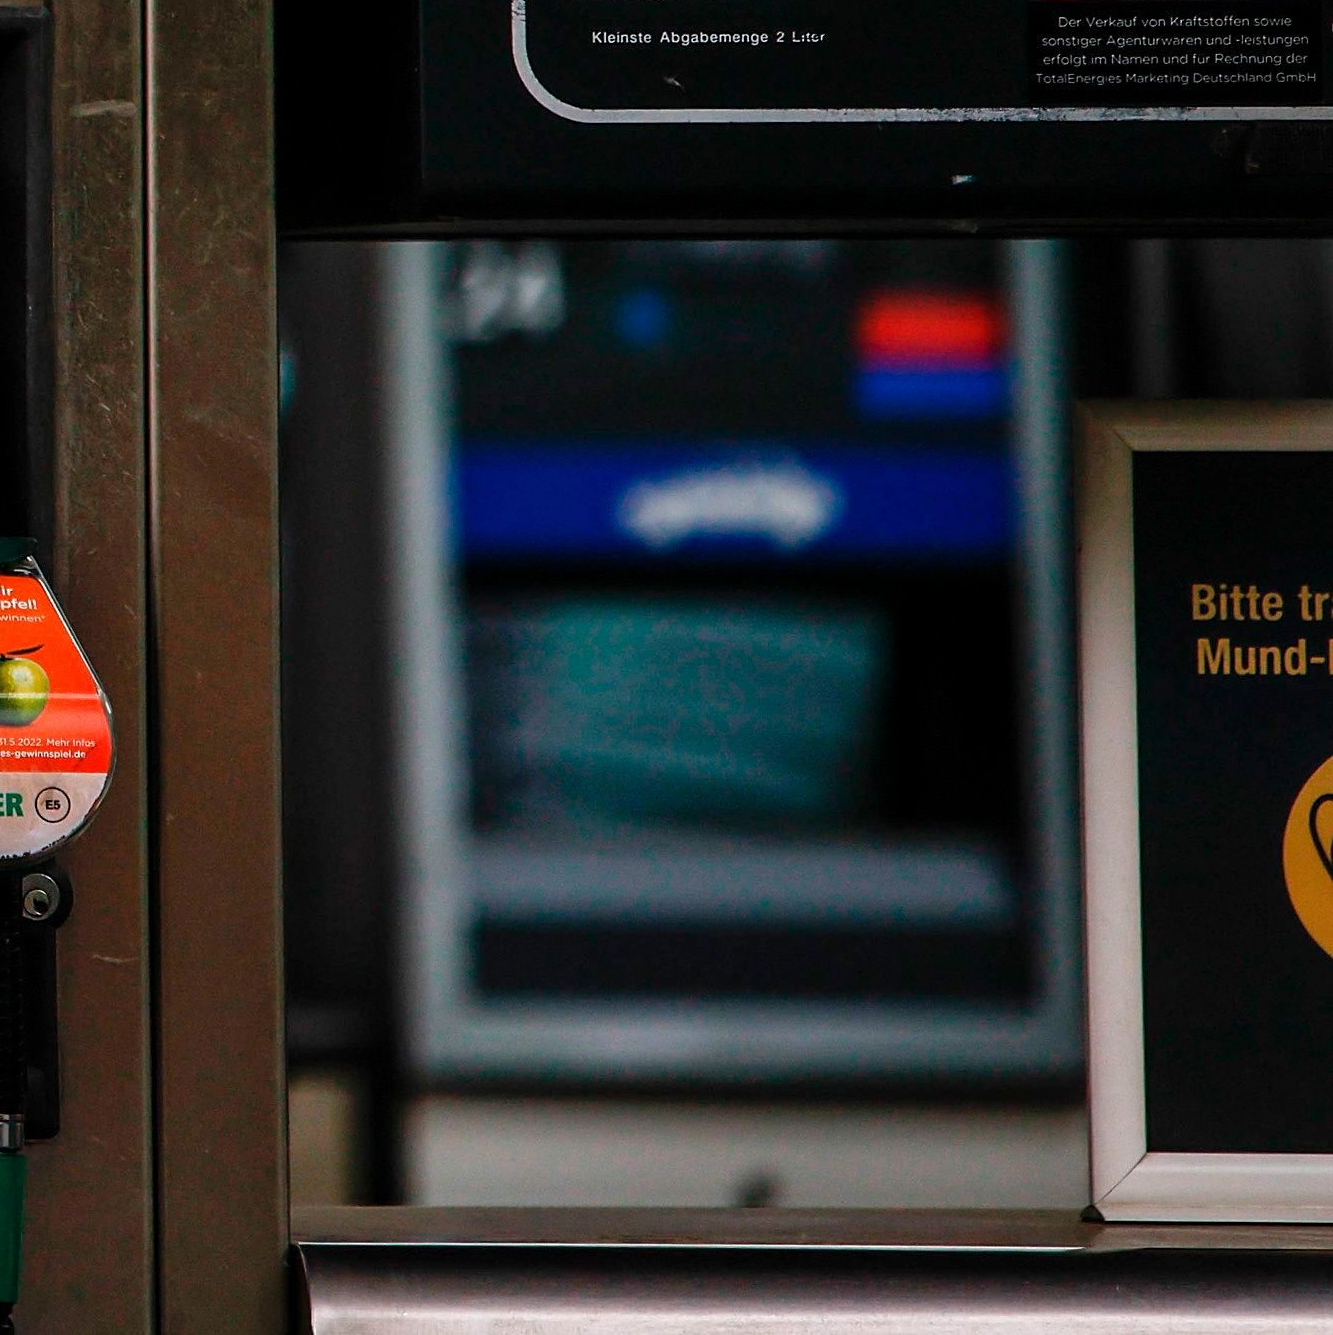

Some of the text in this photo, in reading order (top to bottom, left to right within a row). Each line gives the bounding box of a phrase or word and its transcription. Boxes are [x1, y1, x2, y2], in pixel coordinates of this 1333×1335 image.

[1059, 15, 1291, 28] Der Verkauf von Kraftstoffen sowie
[592, 32, 651, 43] Kleinste
[660, 32, 768, 46] Abgabemenge
[777, 32, 784, 42] 2
[1042, 36, 1102, 49] sonstiger
[1106, 35, 1202, 49] Agenturwaren
[1206, 34, 1231, 46] und
[1043, 53, 1086, 67] erfolgt
[1091, 56, 1106, 65] im
[1111, 54, 1158, 65] Namen
[1163, 54, 1188, 65] und
[1215, 52, 1281, 66] Rechnung
[1286, 52, 1308, 64] der
[1036, 72, 1316, 86] TotalEnergies Marketing Deutschland GmbH
[1192, 584, 1333, 620] Bitte tr
[1198, 638, 1333, 675] Mund-
[46, 739, 69, 747] Mehr
[73, 739, 95, 748] Infos
[45, 799, 61, 810] E5
